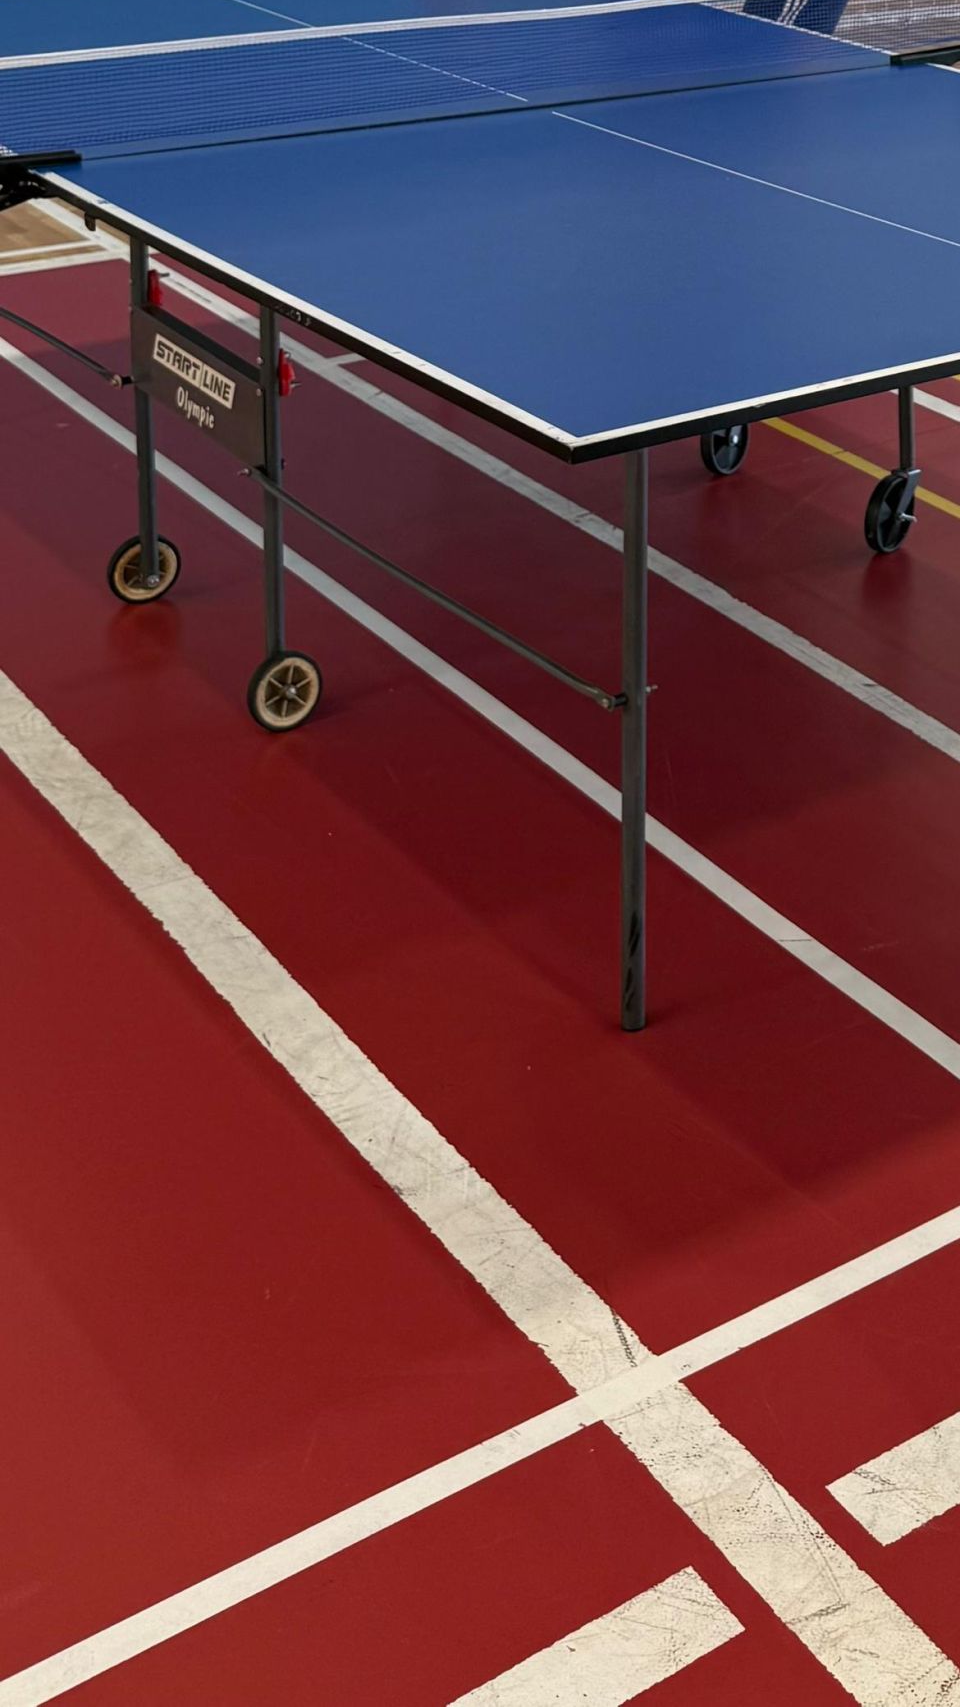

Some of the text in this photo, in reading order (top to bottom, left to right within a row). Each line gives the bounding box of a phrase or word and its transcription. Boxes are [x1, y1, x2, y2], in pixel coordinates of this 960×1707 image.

[157, 341, 231, 401] START LINE
[177, 387, 215, 429] Olympic
